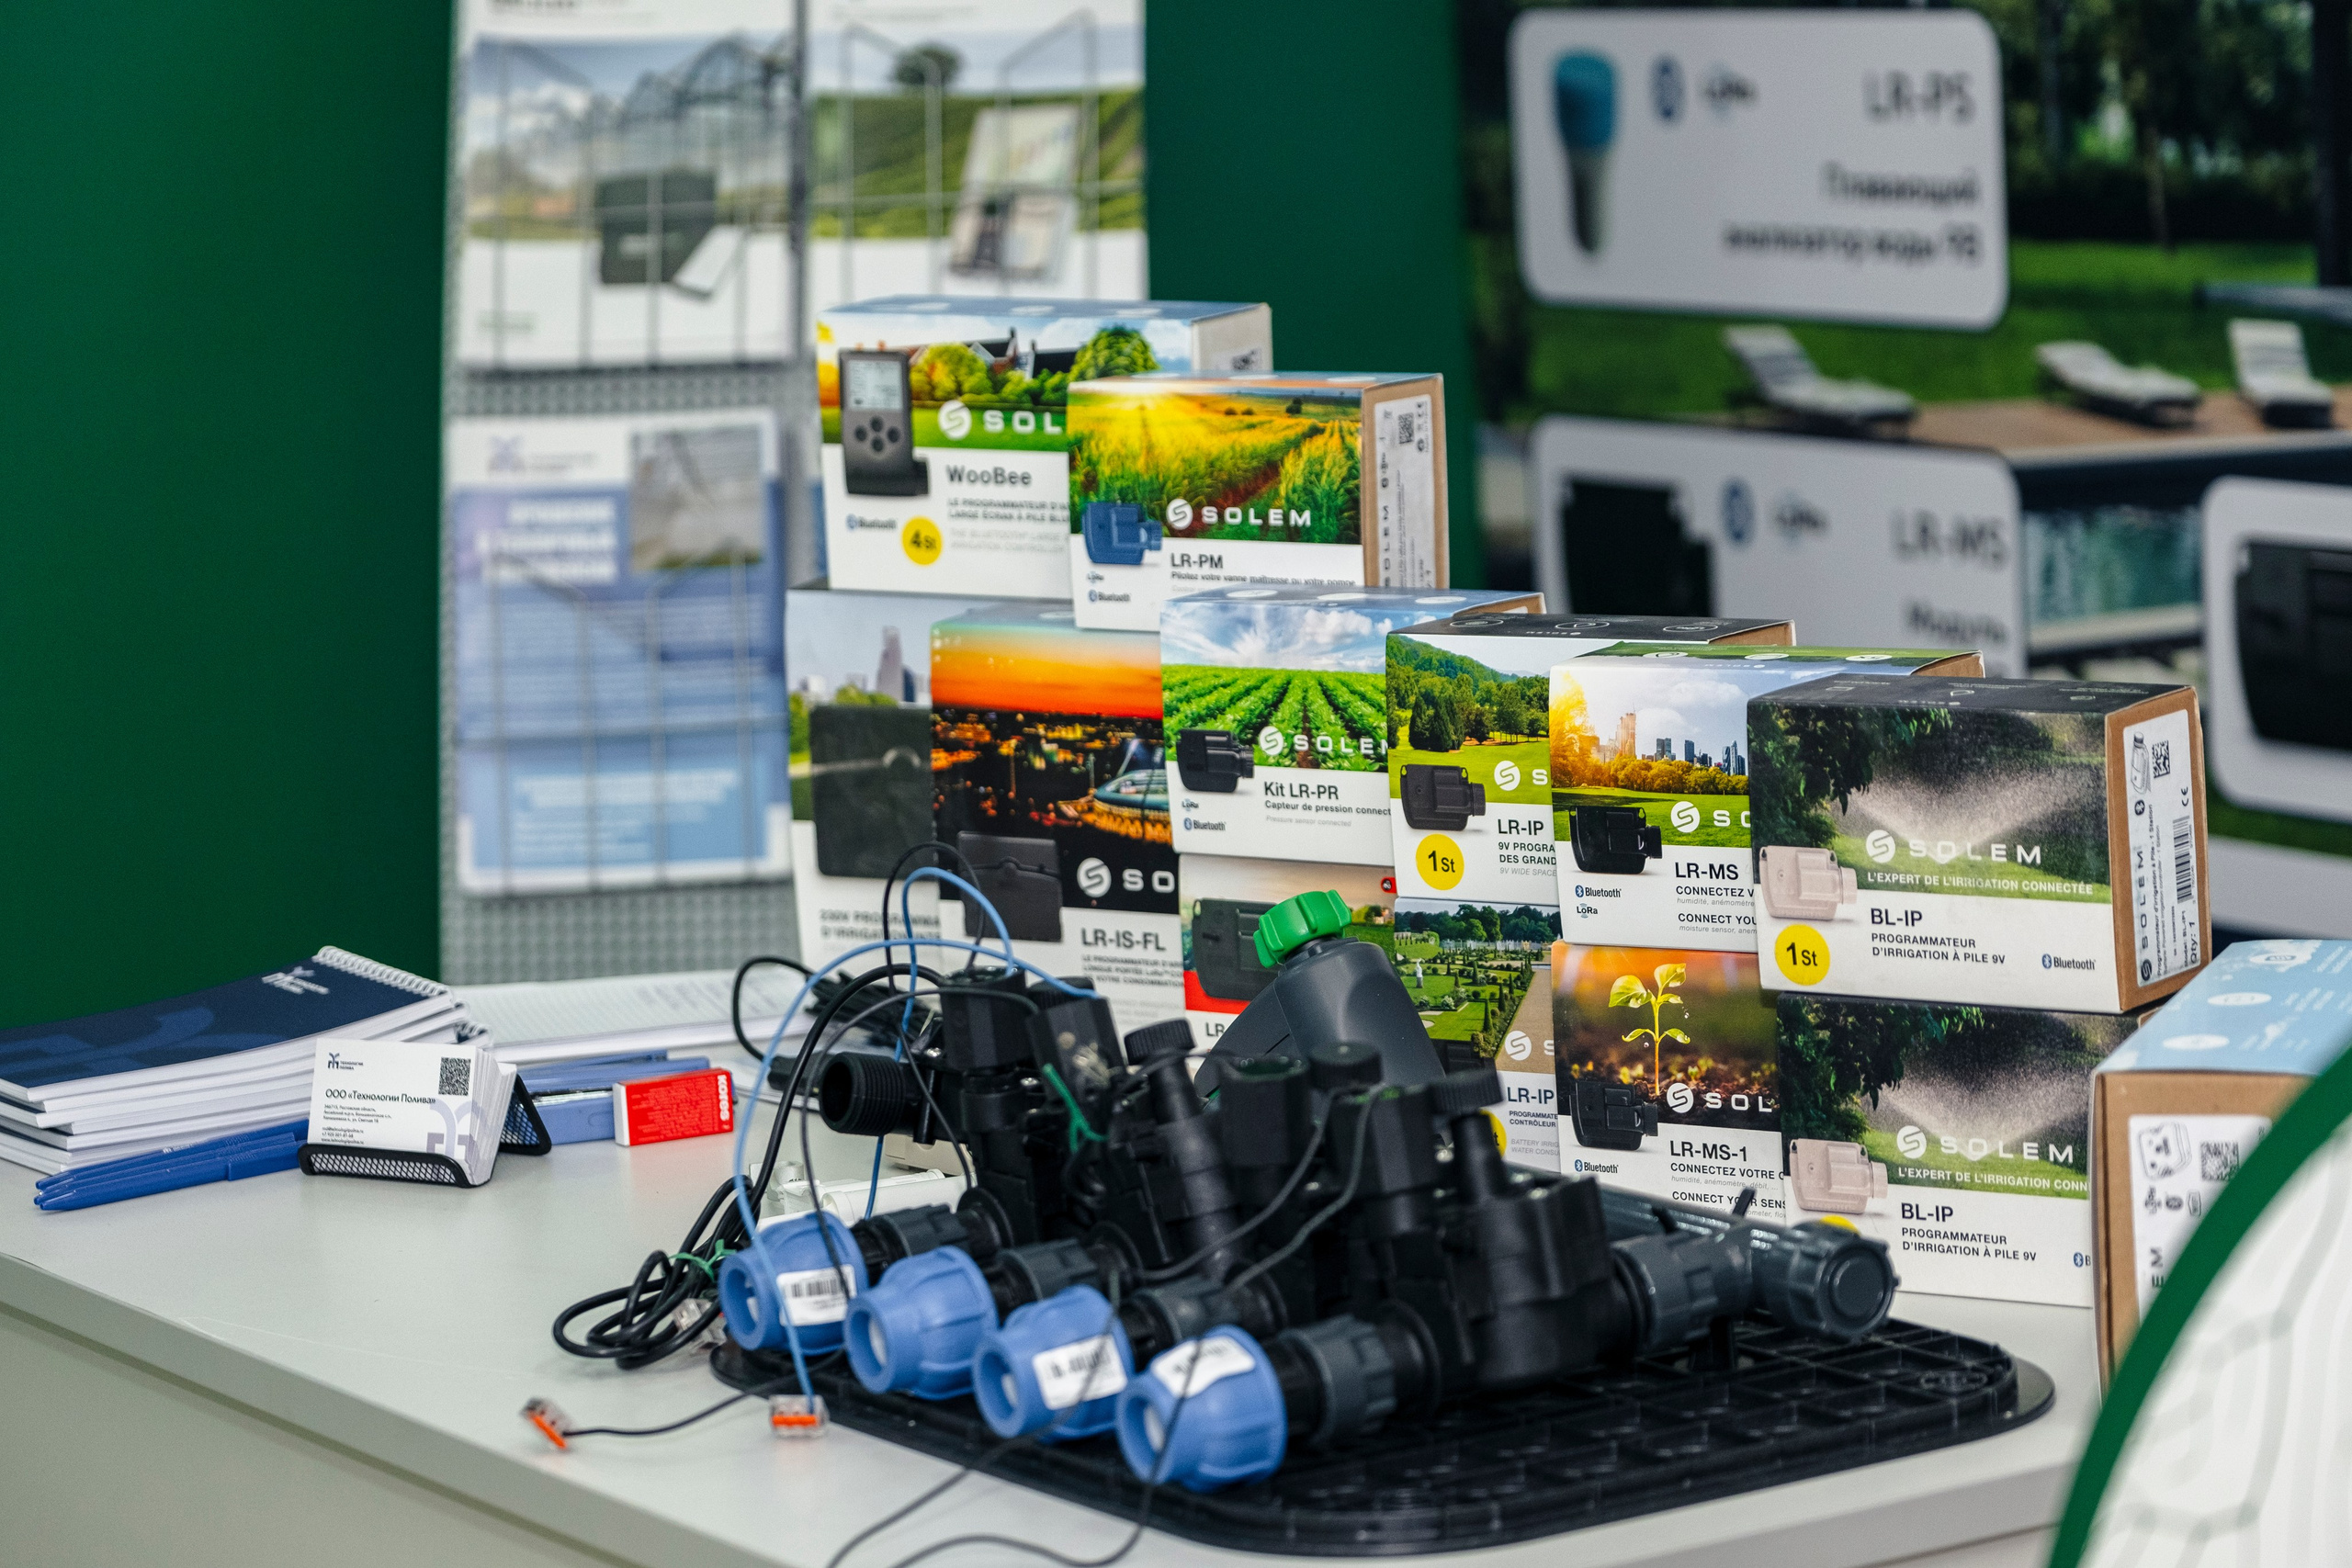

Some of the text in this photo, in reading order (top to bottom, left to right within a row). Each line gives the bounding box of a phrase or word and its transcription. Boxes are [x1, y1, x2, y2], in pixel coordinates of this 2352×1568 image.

[946, 465, 1032, 485] WooBee
[1201, 506, 1312, 528] SOLEM
[1170, 553, 1223, 570] LR-PM
[1532, 769, 1548, 785] S
[1264, 781, 1340, 800] Kit LR-PR
[1264, 799, 1299, 812] Capteur
[1301, 802, 1313, 811] de
[1315, 803, 1353, 815] pression
[1193, 820, 1227, 831] Bluetooth
[1497, 818, 1544, 837] LR-IP
[1498, 841, 1511, 852] 9V
[1909, 840, 2041, 864] SOLEM
[1498, 853, 1556, 865] DES GRAND
[1499, 866, 1556, 877] 9V WIDE SPACE
[1675, 862, 1739, 881] LR-MS
[1123, 869, 1175, 894] SO
[1868, 872, 2094, 895] L'EXPERT DE L'IRRIGATION CONNECTÉE
[1584, 886, 1623, 898] Bluetooth
[1676, 886, 1745, 897] CONNECTEZ
[1677, 897, 1709, 906] humidité,
[2137, 851, 2149, 950] SOLEM
[1577, 905, 1599, 916] LoRa
[1678, 912, 1732, 924] CONNECT
[1871, 908, 1923, 927] BL-IP
[1679, 924, 1709, 932] moisture
[1711, 925, 1736, 934] sensor,
[1081, 928, 1167, 952] LR-IS-FL
[1871, 932, 1976, 948] PROGRAMMATEUR
[2189, 933, 2198, 964] Qty:
[1872, 946, 2006, 964] D'IRRIGATION À PILE 9V
[2052, 956, 2097, 971] Bluetooth
[325, 1089, 436, 1104] ООО «Технологии Полива»
[1507, 1087, 1555, 1105] LR-IP
[1706, 1092, 1772, 1113] SOL
[1509, 1110, 1558, 1120] PROGRAMMATE
[1510, 1118, 1556, 1127] CONTRÔLEUR
[1511, 1138, 1539, 1146] BATTERY
[1940, 1135, 2074, 1164] SOLEM
[1669, 1140, 1747, 1162] LR-MS-1
[1583, 1162, 1619, 1174] Bluetooth
[1670, 1162, 1736, 1177] CONNECTEZ
[1739, 1168, 1775, 1180] VOTRE
[1671, 1176, 1702, 1185] humidité,
[1898, 1167, 1951, 1180] L'EXPERT
[1955, 1171, 1971, 1182] DE
[1974, 1173, 2051, 1189] L'IRRIGATION
[1672, 1190, 1724, 1204] CONNECT
[1901, 1201, 1954, 1223] BL-IP
[1902, 1226, 2007, 1245] PROGRAMMATEUR
[1903, 1241, 2037, 1261] D'IRRIGATION À PILE 9V
